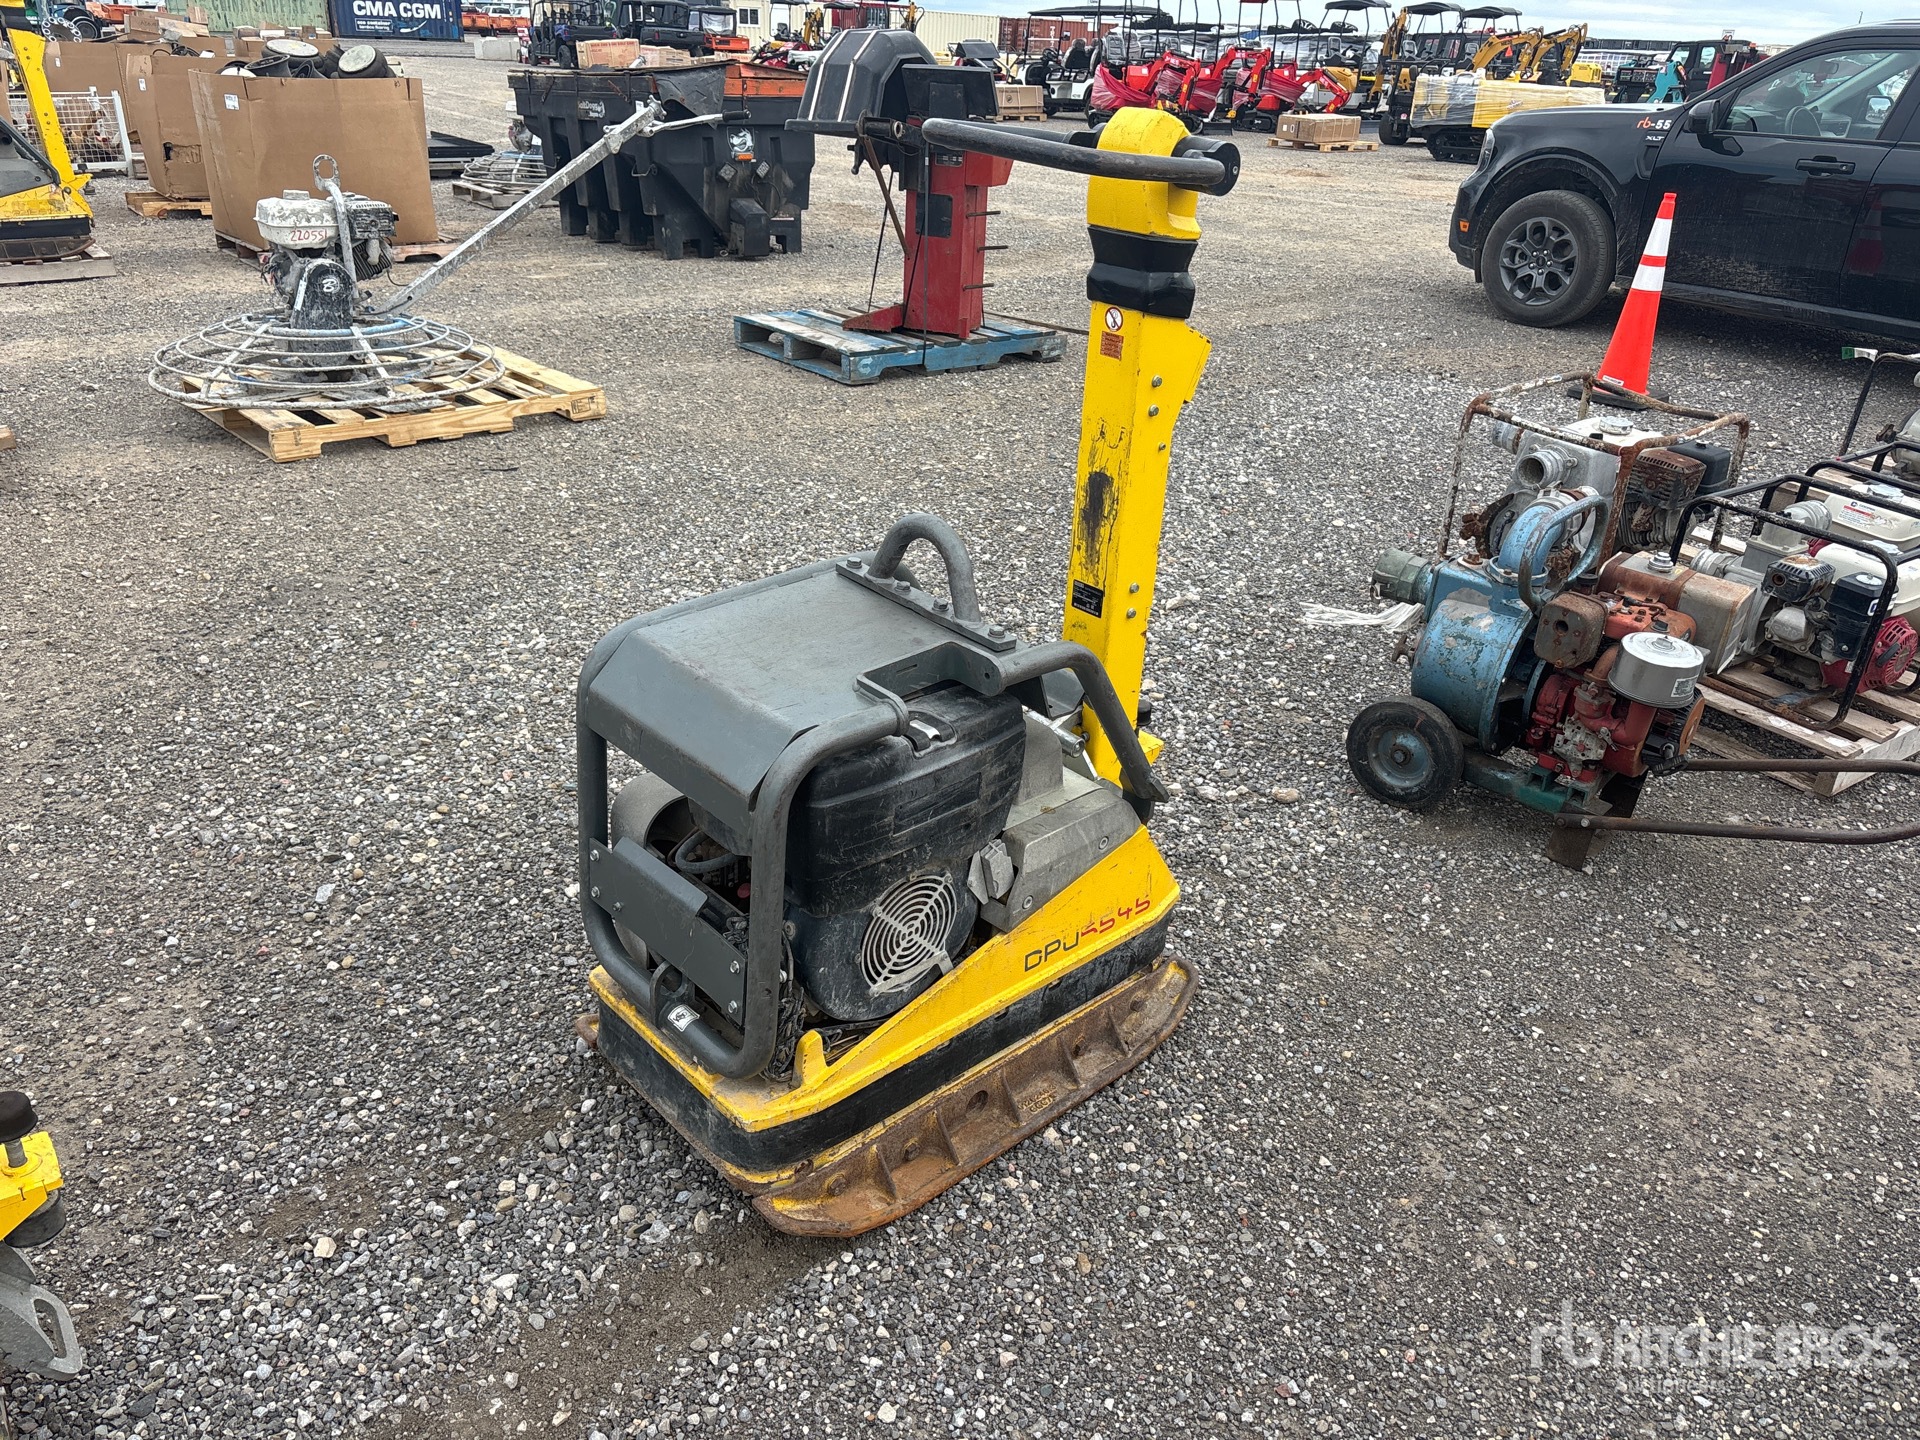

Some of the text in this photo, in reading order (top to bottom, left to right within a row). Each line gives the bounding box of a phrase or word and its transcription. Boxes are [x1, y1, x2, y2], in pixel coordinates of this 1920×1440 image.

[353, 1, 441, 19] CMA CGM
[1637, 117, 1672, 129] rb-55
